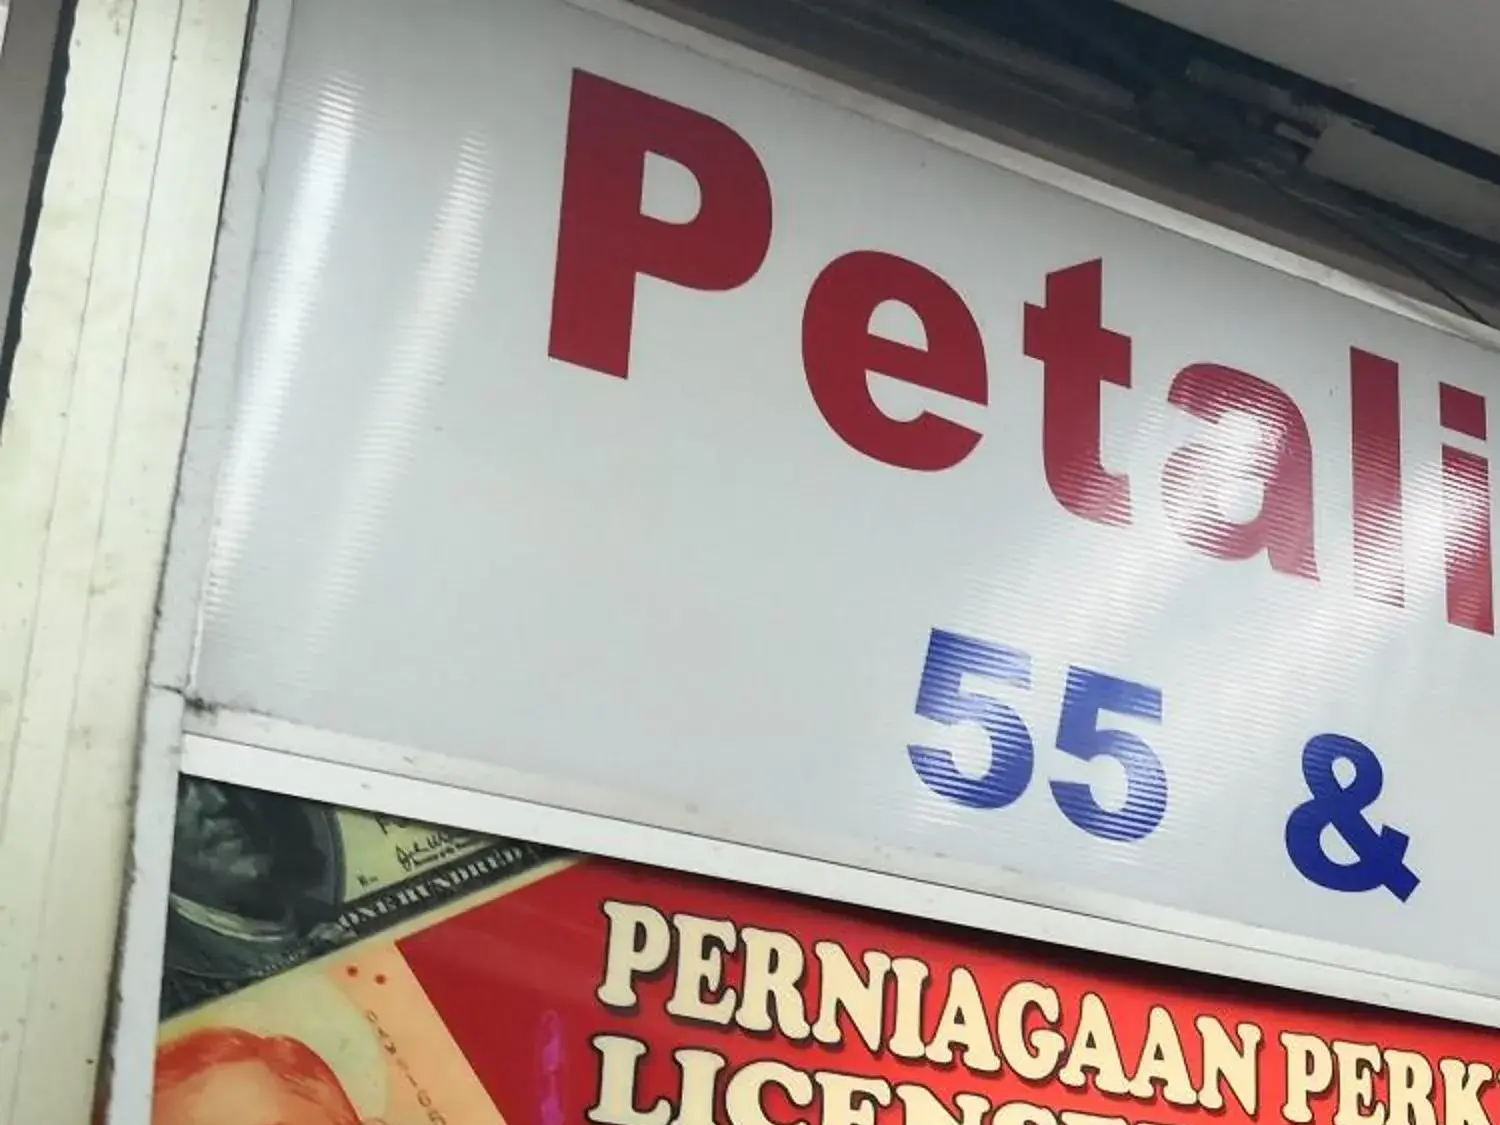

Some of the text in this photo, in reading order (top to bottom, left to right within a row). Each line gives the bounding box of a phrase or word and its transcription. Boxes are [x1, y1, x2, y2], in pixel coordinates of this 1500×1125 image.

[907, 628, 1168, 843] 55
[1285, 732, 1421, 903] &
[598, 899, 1262, 1115] PERNIAGAAN
